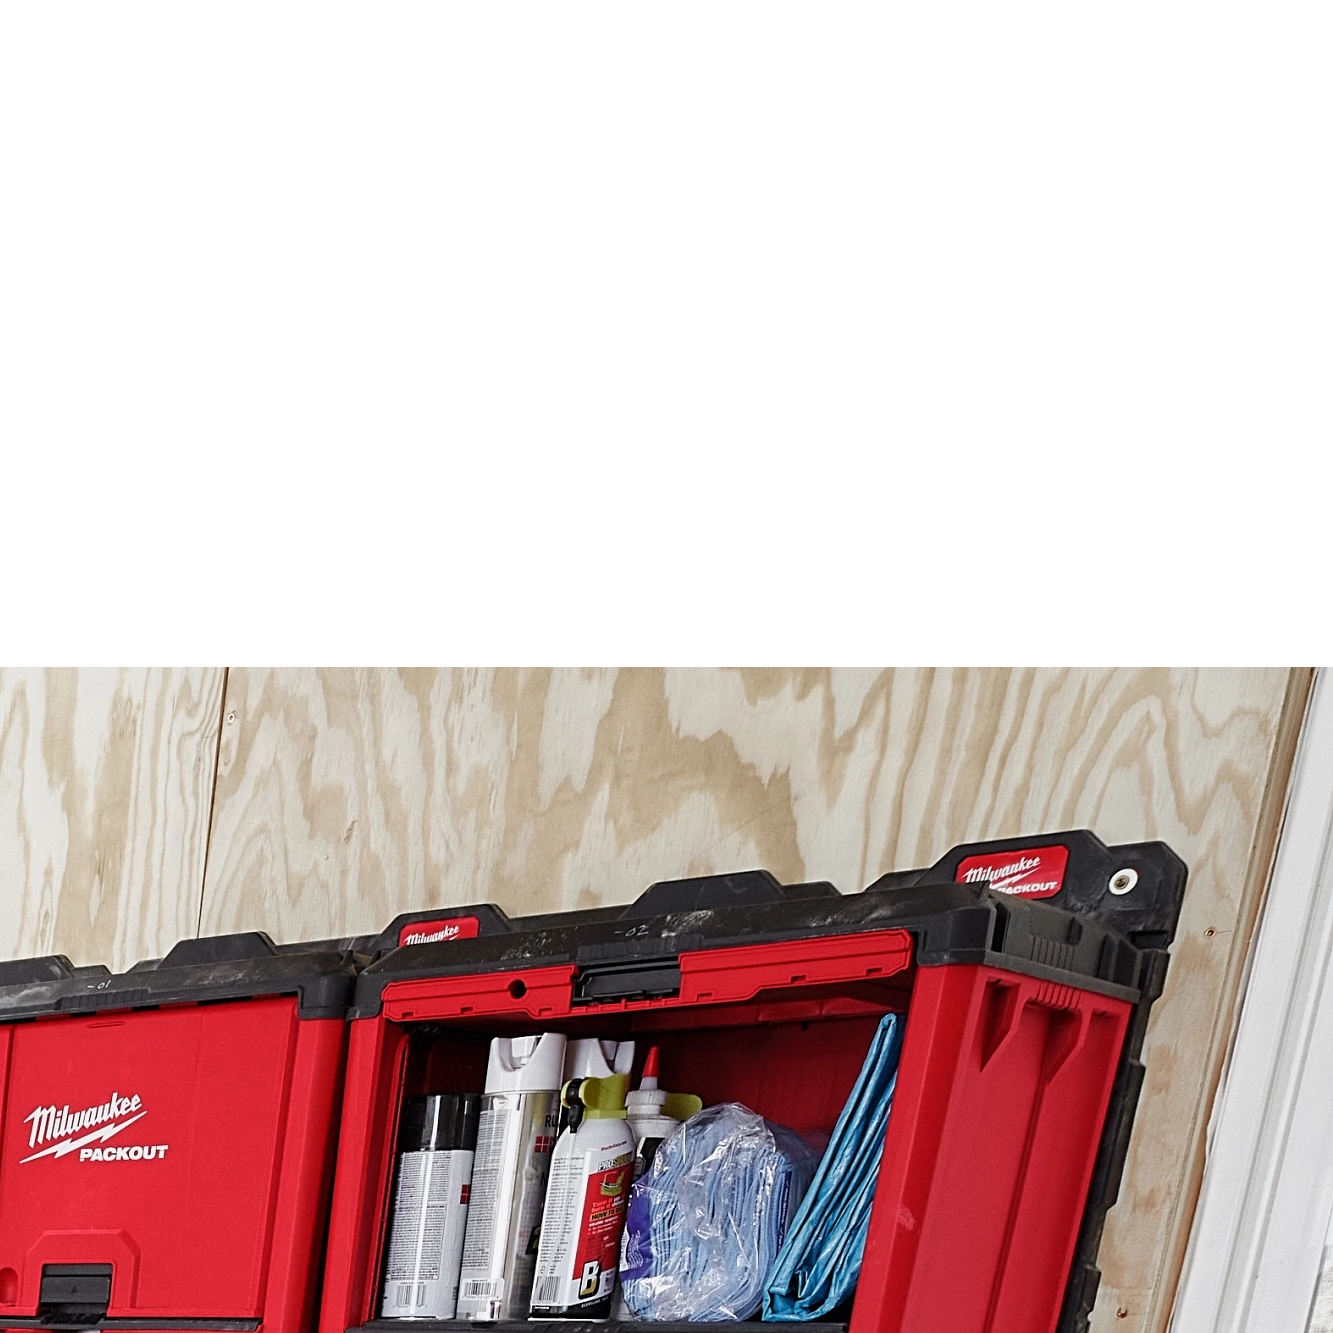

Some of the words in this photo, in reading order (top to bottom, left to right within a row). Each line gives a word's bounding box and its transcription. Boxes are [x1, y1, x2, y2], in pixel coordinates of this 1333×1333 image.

[962, 857, 1041, 883] Milwaukee
[24, 1092, 143, 1148] Milwaukee
[79, 1144, 169, 1162] PACKOUT
